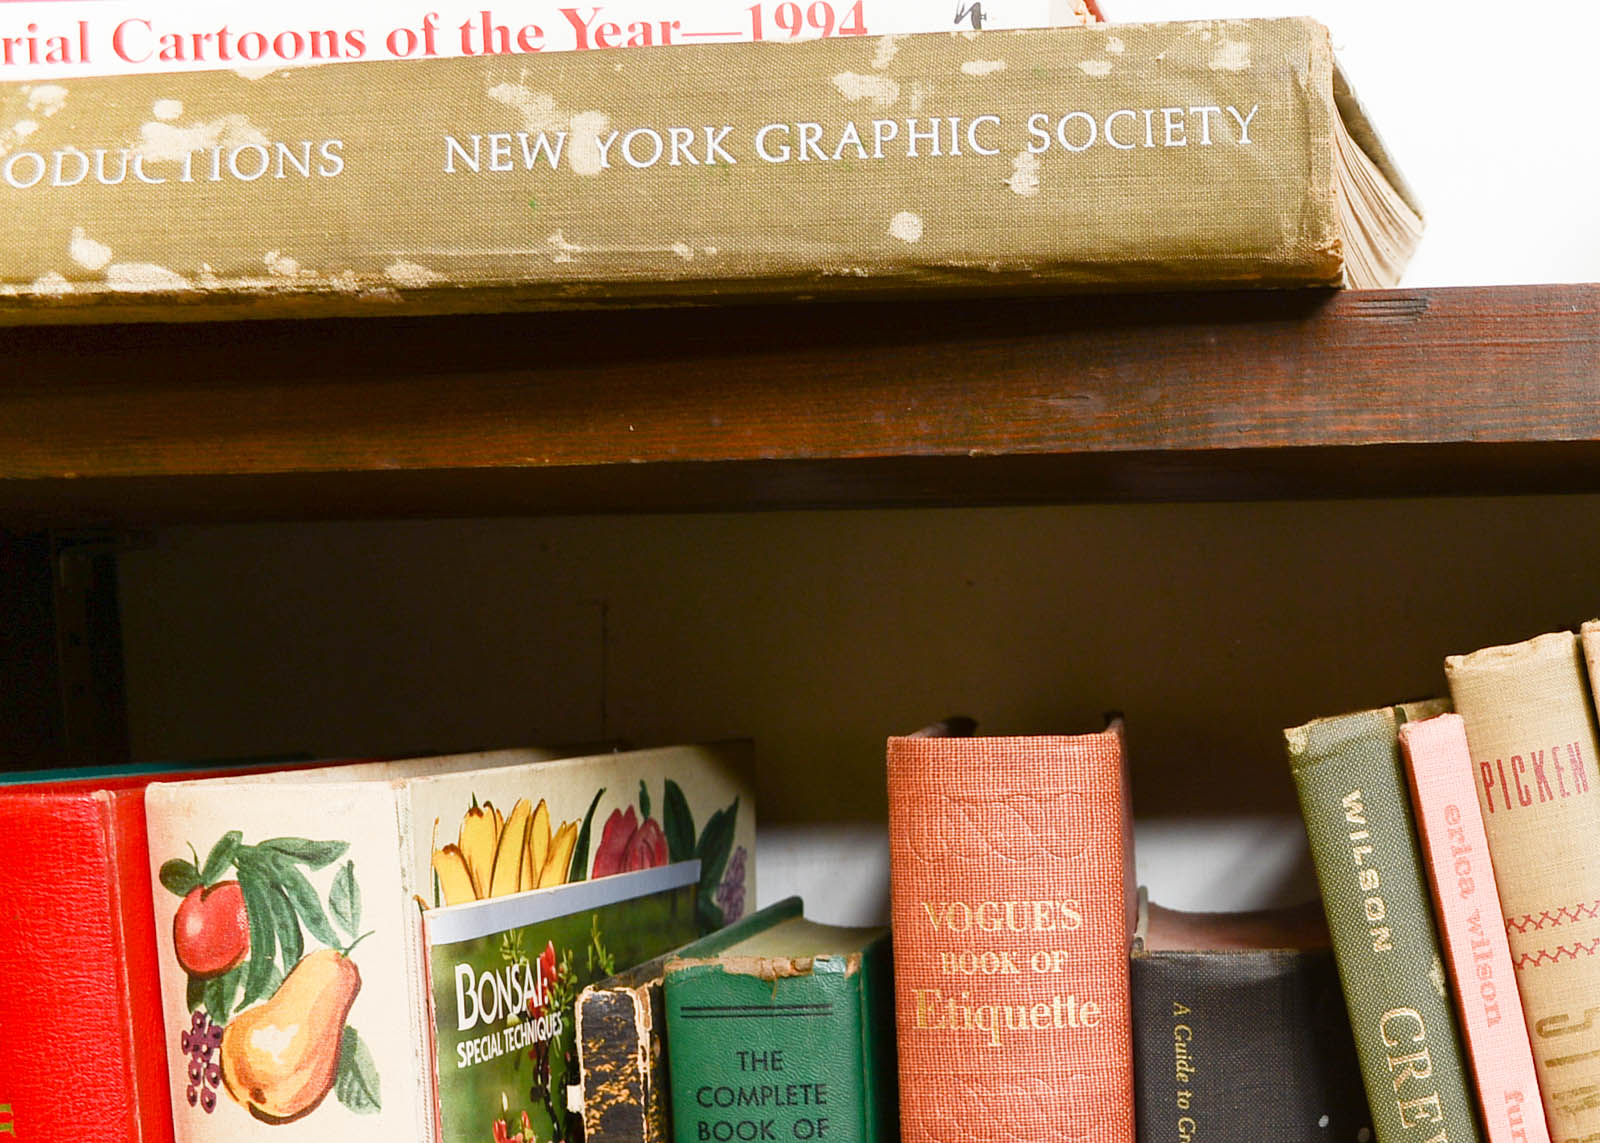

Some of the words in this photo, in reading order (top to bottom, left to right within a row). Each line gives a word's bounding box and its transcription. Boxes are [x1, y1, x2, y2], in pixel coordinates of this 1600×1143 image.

[111, 17, 367, 63] Cartoons
[385, 13, 441, 58] of
[461, 11, 546, 55] the
[443, 132, 567, 174] NEW
[592, 126, 735, 170] YORK
[755, 115, 1001, 164] GRAPHIC
[1027, 104, 1259, 153] SOCIETY
[1479, 740, 1591, 814] PICKEN
[1342, 789, 1393, 953] WILSON
[920, 899, 1082, 932] VOGUE'S
[1443, 803, 1475, 900] erica
[1466, 908, 1502, 1028] wilson
[940, 951, 1020, 975] BOOK
[1030, 950, 1069, 974] OF
[911, 989, 1101, 1047] Etiquette
[1173, 1001, 1192, 1017] A
[457, 1029, 503, 1069] SPECIAL
[504, 1010, 563, 1054] TECHNIQUES
[737, 1050, 784, 1072] THE
[1174, 1023, 1195, 1083] Guide
[696, 1083, 828, 1108] COMPLETE
[1177, 1089, 1193, 1109] to
[697, 1120, 777, 1143] BOOK
[792, 1117, 830, 1140] OF
